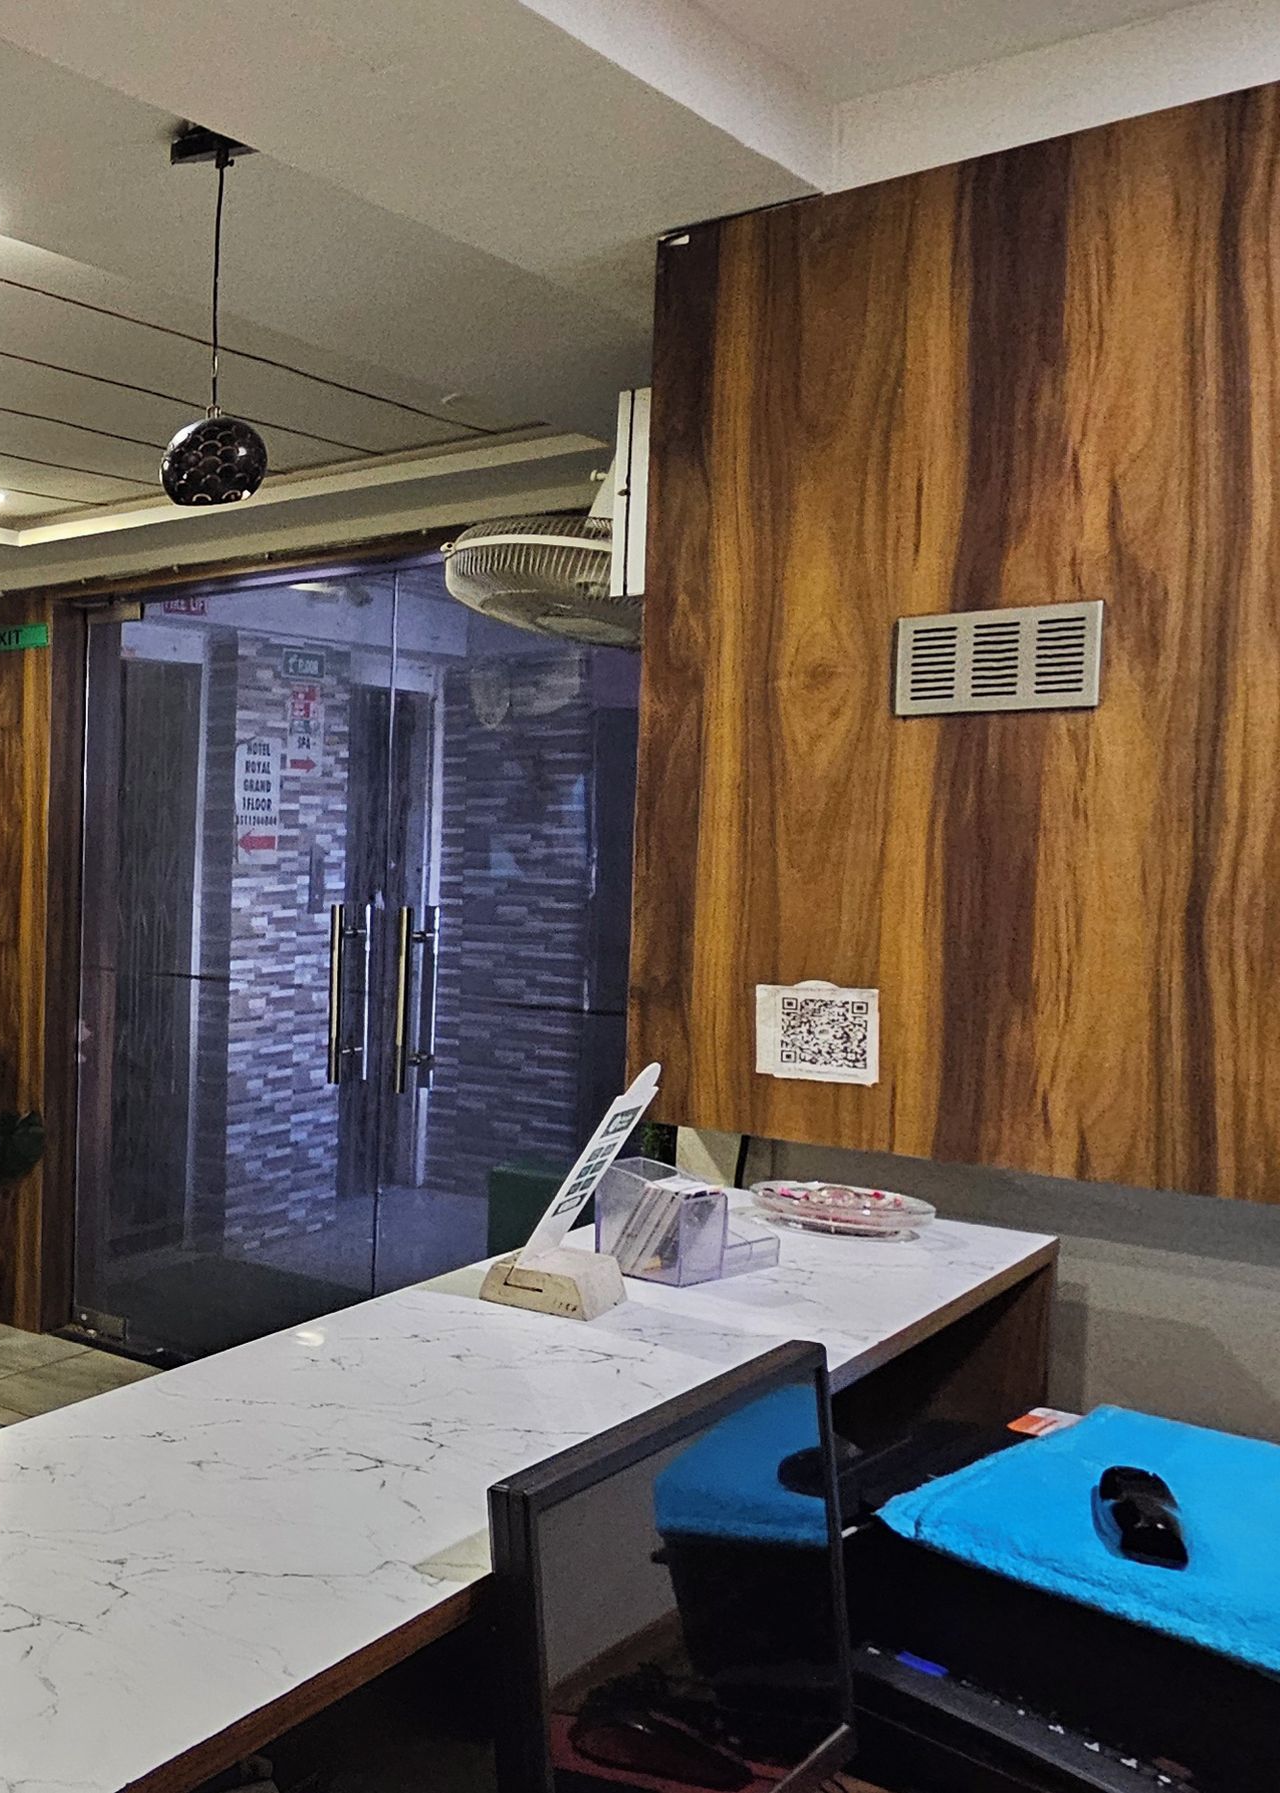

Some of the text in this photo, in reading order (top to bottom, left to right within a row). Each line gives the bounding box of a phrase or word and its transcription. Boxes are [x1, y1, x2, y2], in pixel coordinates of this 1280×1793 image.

[246, 743, 271, 757] HOTEL
[245, 760, 271, 775] ROYAL
[243, 779, 272, 794] GRAND
